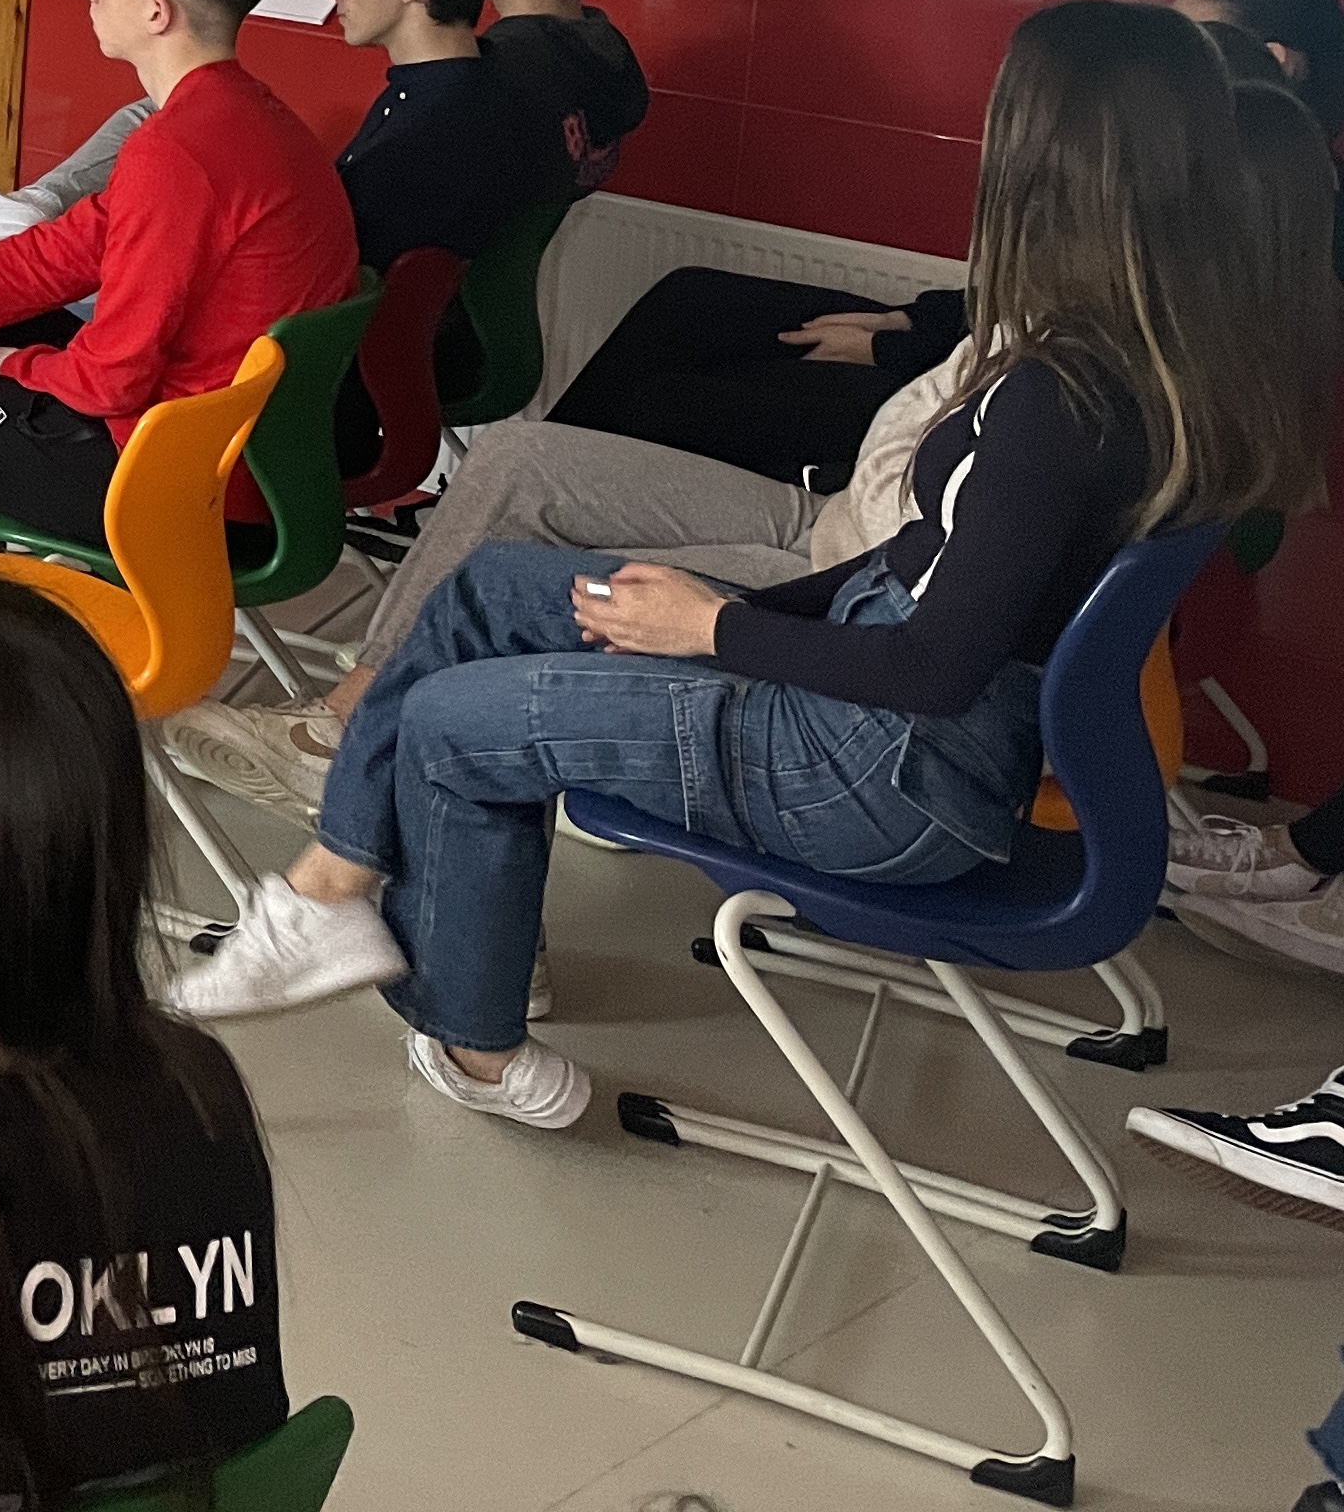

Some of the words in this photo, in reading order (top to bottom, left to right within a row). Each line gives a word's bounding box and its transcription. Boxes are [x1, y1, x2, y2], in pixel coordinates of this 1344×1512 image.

[80, 1355, 111, 1376] DAY
[112, 1352, 129, 1372] IN
[203, 1337, 215, 1354] IS
[215, 1354, 231, 1371] TO
[232, 1346, 257, 1368] MISS
